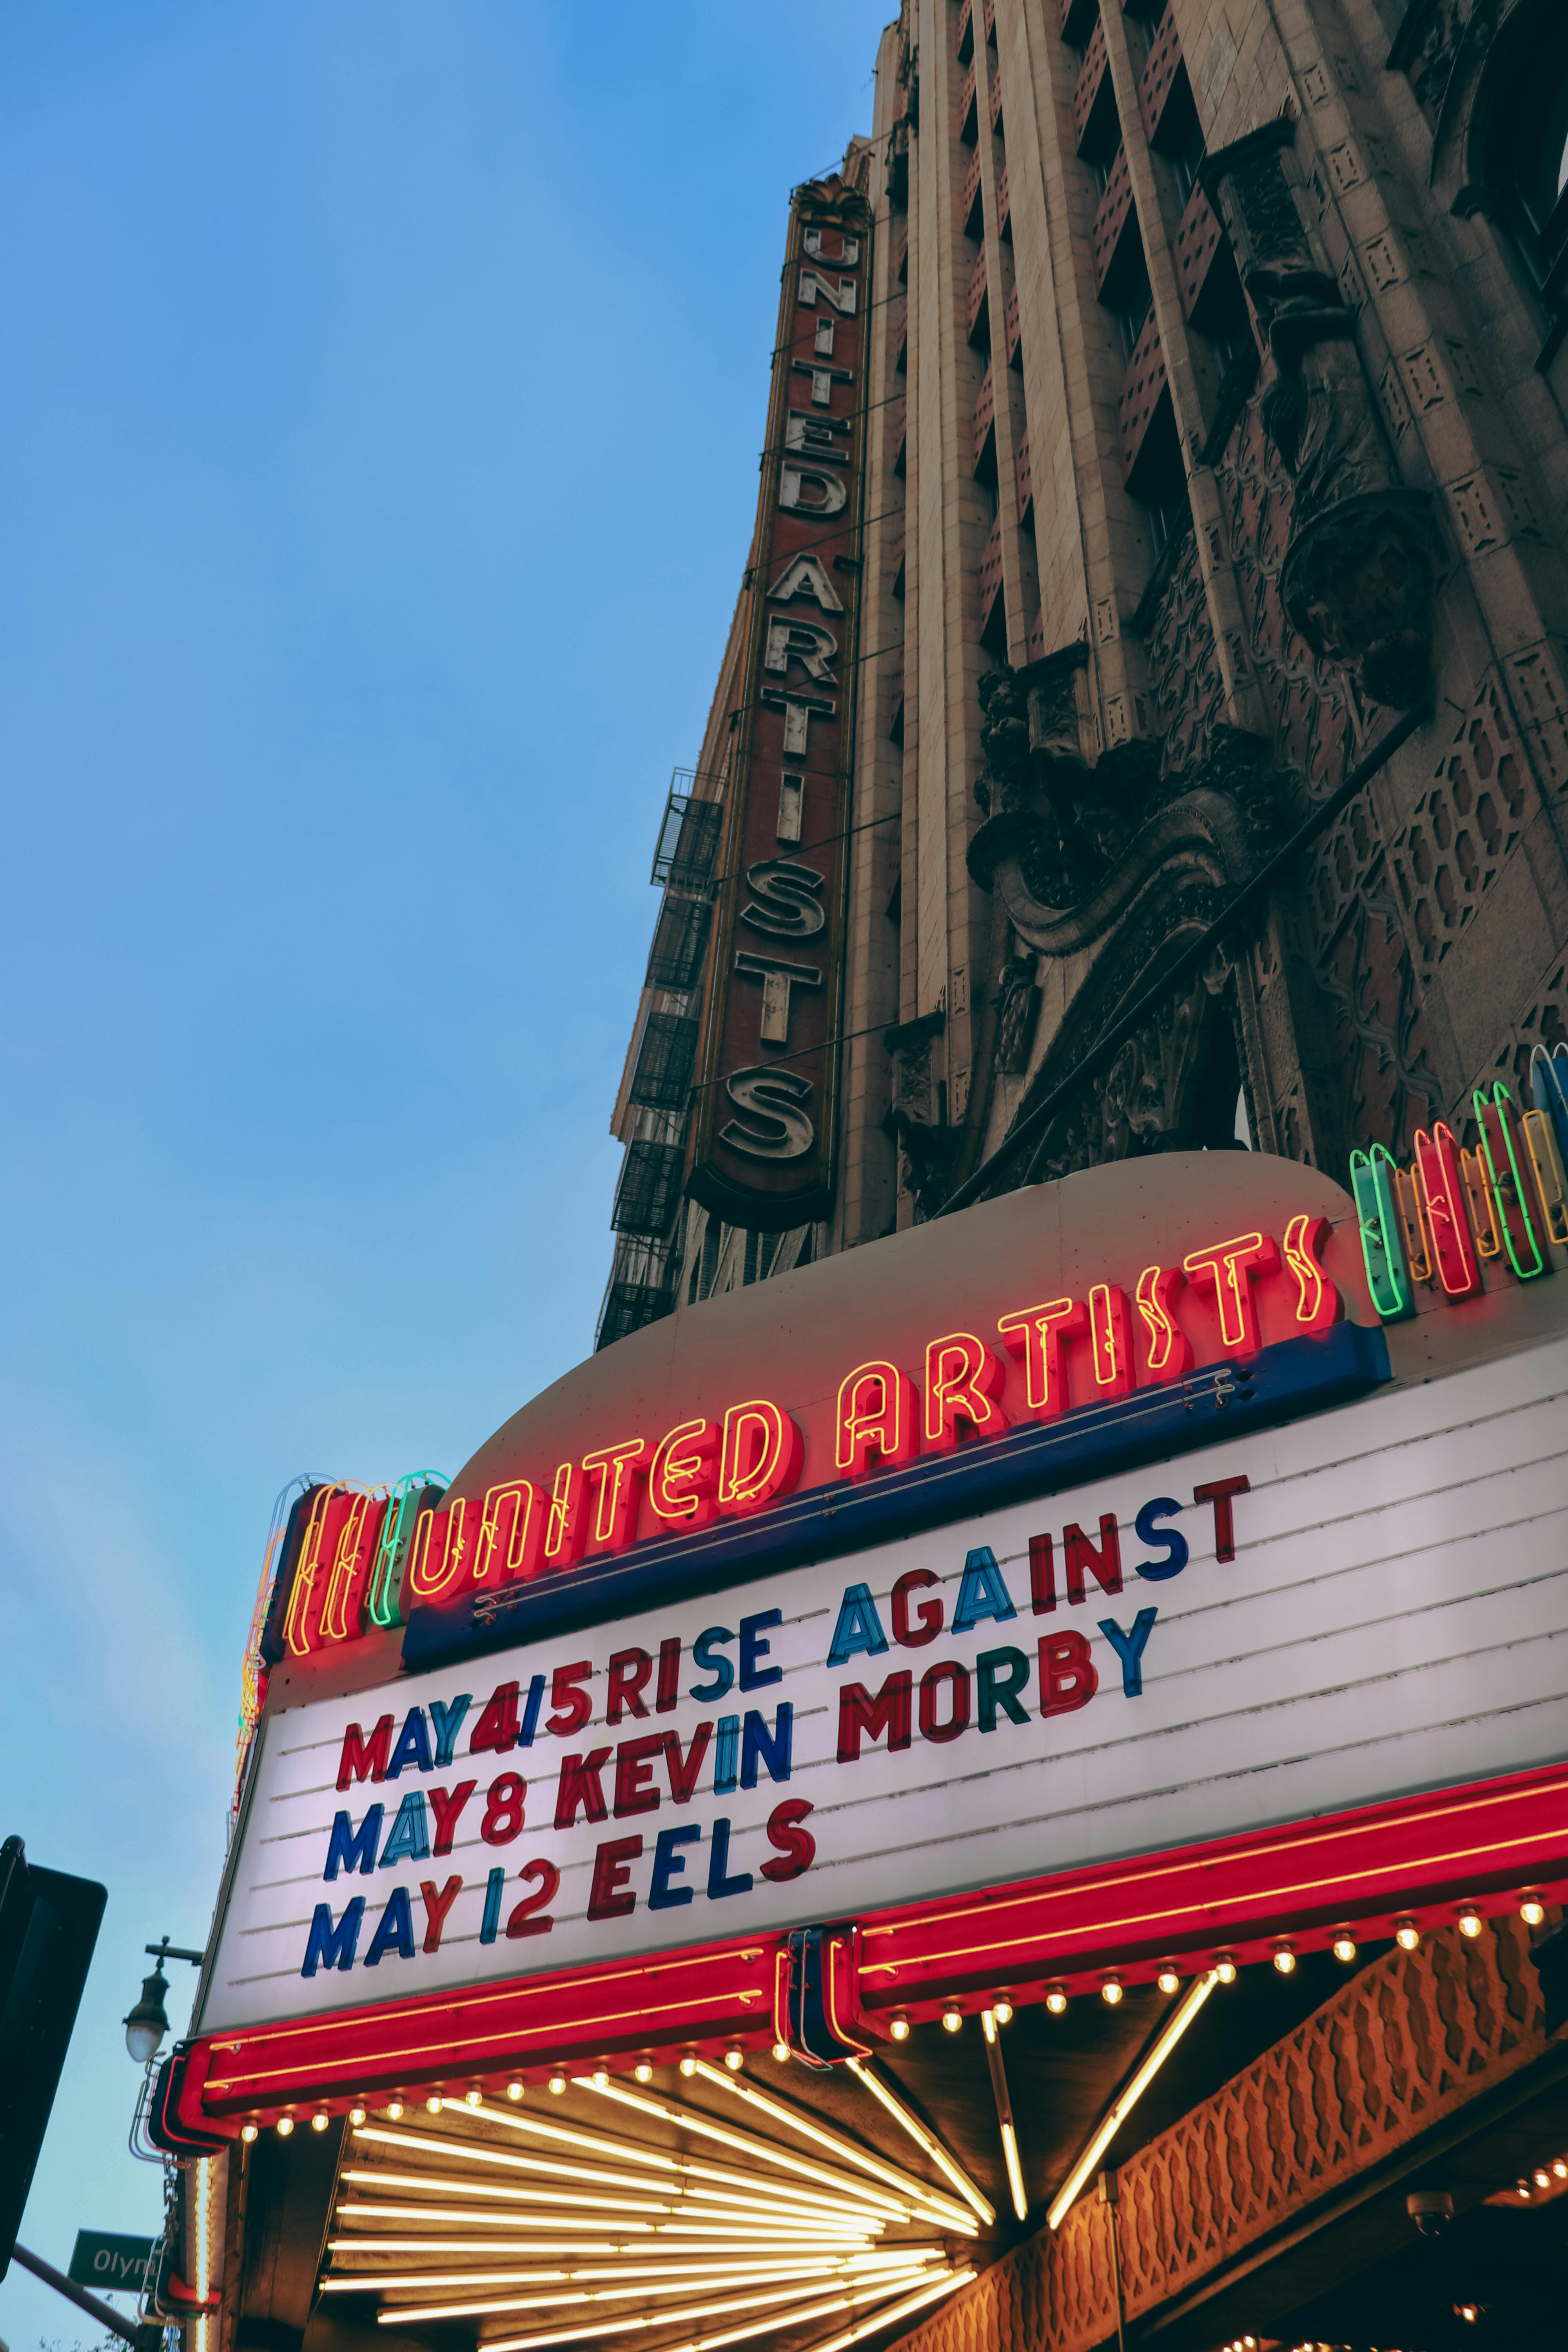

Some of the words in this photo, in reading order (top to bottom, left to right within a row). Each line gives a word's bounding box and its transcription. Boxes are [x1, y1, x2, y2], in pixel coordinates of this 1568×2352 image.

[779, 227, 858, 514] UNITED
[719, 553, 844, 1159] ARTISTS
[409, 1399, 805, 1604] UNITED
[835, 1214, 1345, 1486] ARTISTS
[323, 1780, 478, 1881] MAY
[481, 1771, 527, 1846] 8
[554, 1702, 793, 1830] KEVIN
[836, 1606, 1158, 1764] MORBY
[336, 1693, 473, 1792] MAY
[606, 1608, 782, 1726] RISE
[826, 1475, 1250, 1668] AGAINST
[301, 1875, 463, 1978] MAY
[479, 1858, 561, 1944] 12
[586, 1798, 816, 1921] EELS
